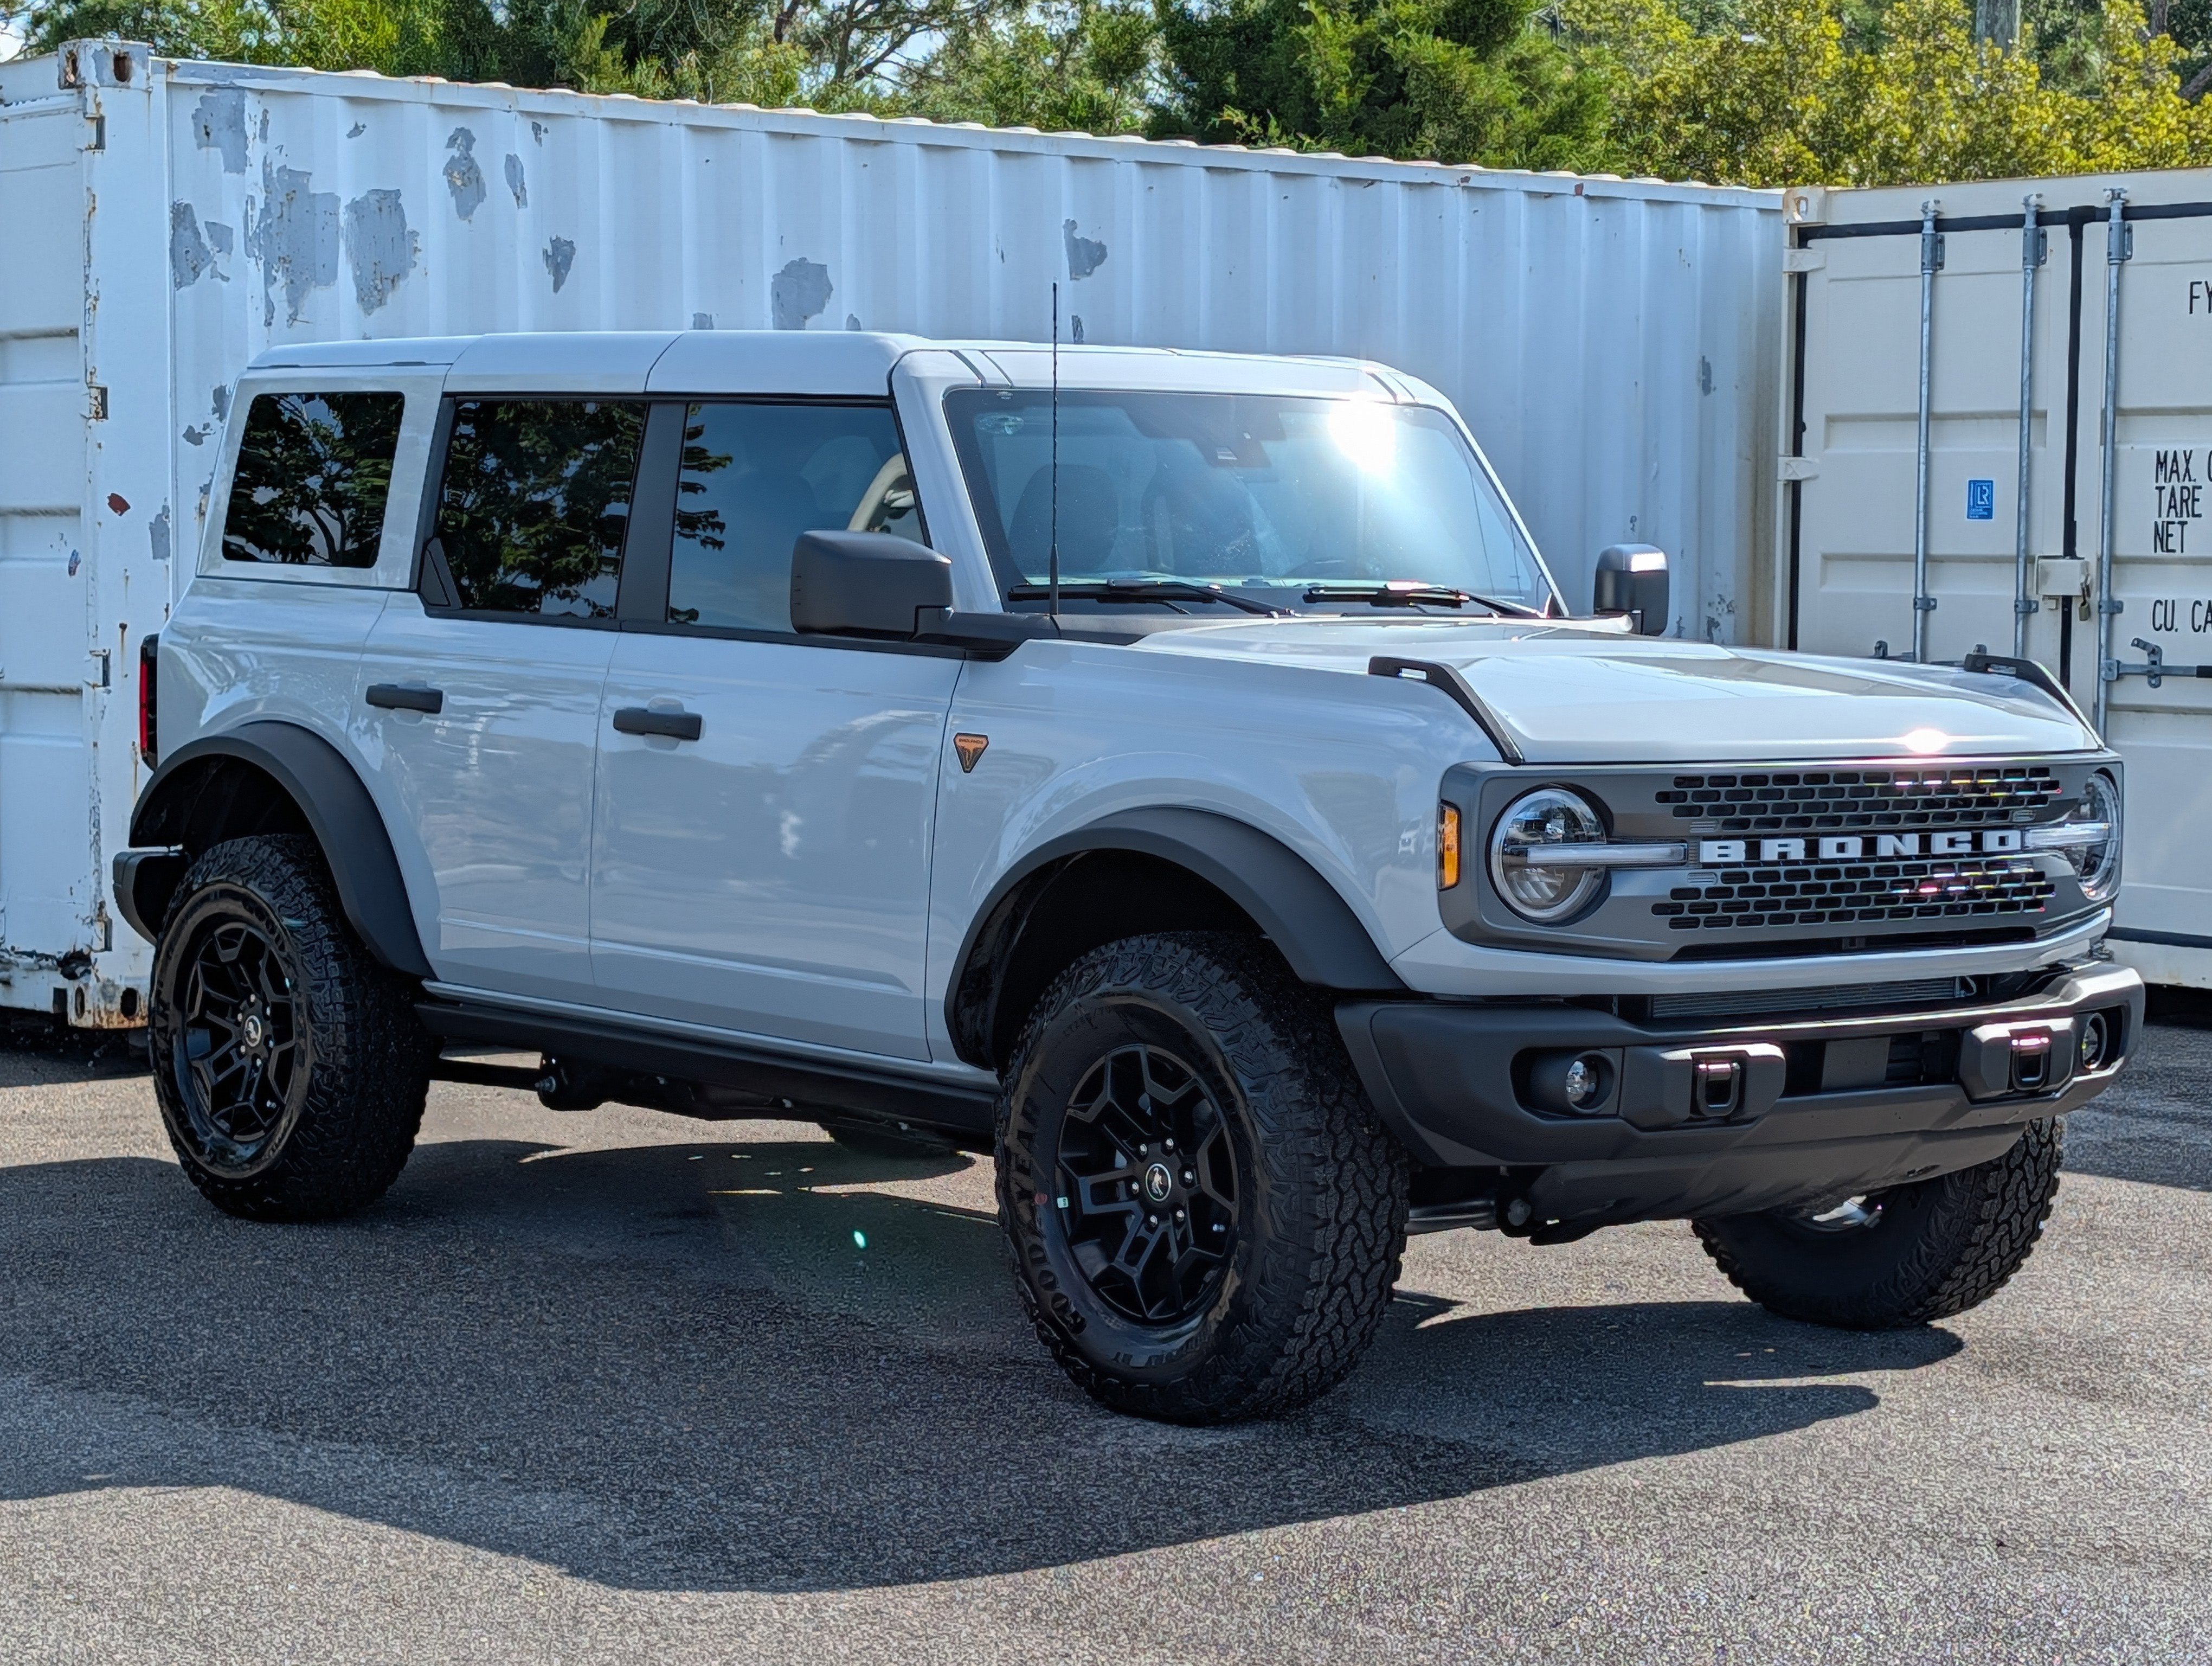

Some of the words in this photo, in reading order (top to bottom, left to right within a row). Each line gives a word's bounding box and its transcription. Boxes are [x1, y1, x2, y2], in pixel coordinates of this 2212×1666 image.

[2189, 281, 2212, 314] FY
[2155, 450, 2196, 483] MAX.
[2155, 485, 2202, 518] TARE
[2154, 521, 2188, 553] NET
[2152, 599, 2178, 632] CU.
[1700, 830, 2022, 863] BRONCO
